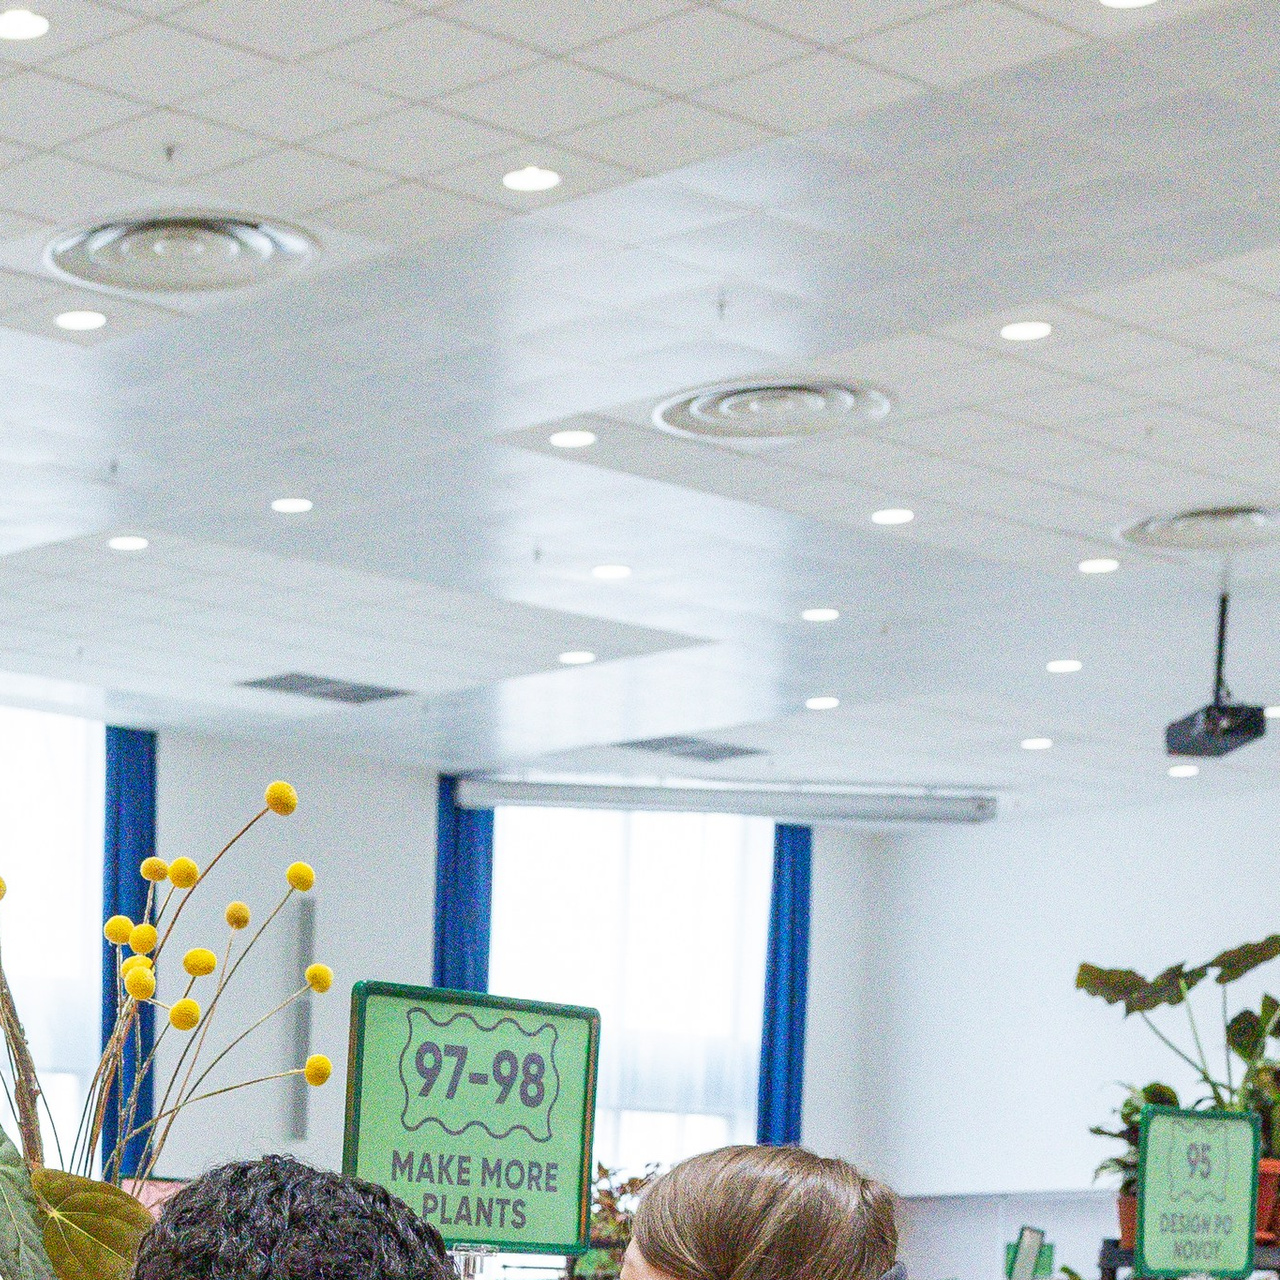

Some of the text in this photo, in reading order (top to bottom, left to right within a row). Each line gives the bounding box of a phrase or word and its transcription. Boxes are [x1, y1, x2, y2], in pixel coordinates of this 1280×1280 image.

[415, 1041, 546, 1108] 97-98
[391, 1150, 559, 1193] MAKE MORE
[1186, 1143, 1213, 1179] 95
[422, 1192, 527, 1230] PLANTS
